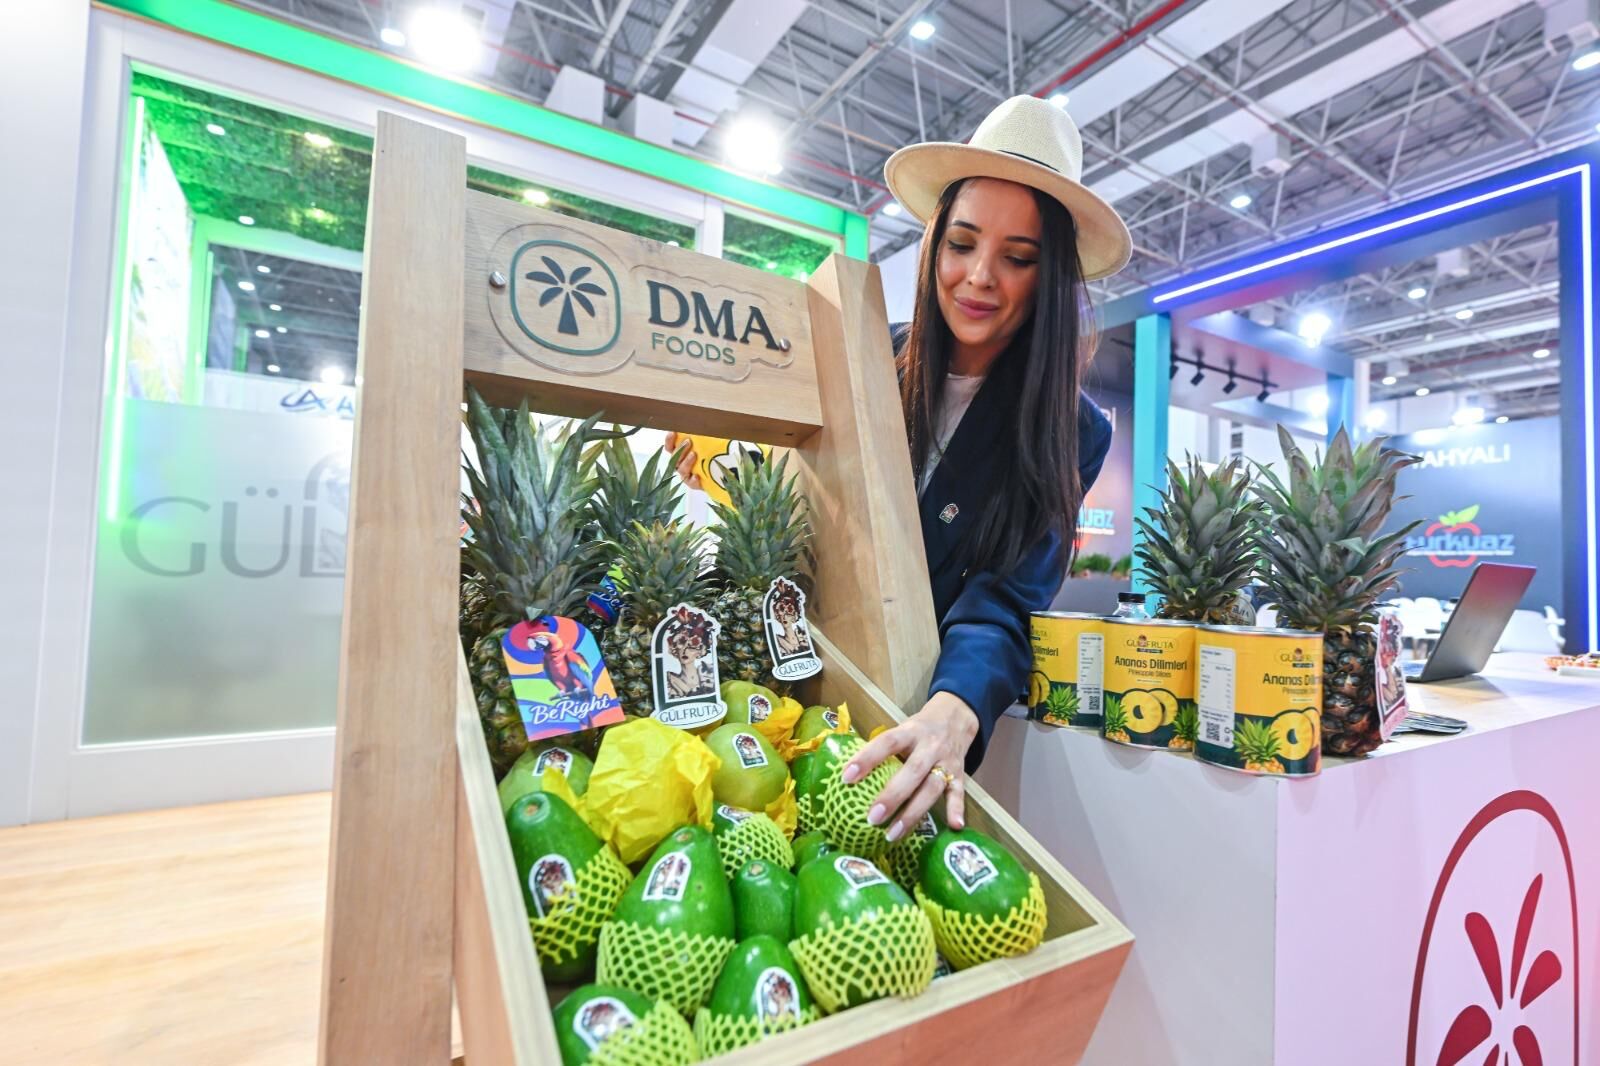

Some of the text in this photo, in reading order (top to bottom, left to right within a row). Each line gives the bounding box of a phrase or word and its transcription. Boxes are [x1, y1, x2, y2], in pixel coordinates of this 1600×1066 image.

[646, 280, 780, 351] DMA
[652, 332, 736, 366] FOODS
[1114, 655, 1148, 668] Ananas
[1263, 673, 1303, 686] Ananas
